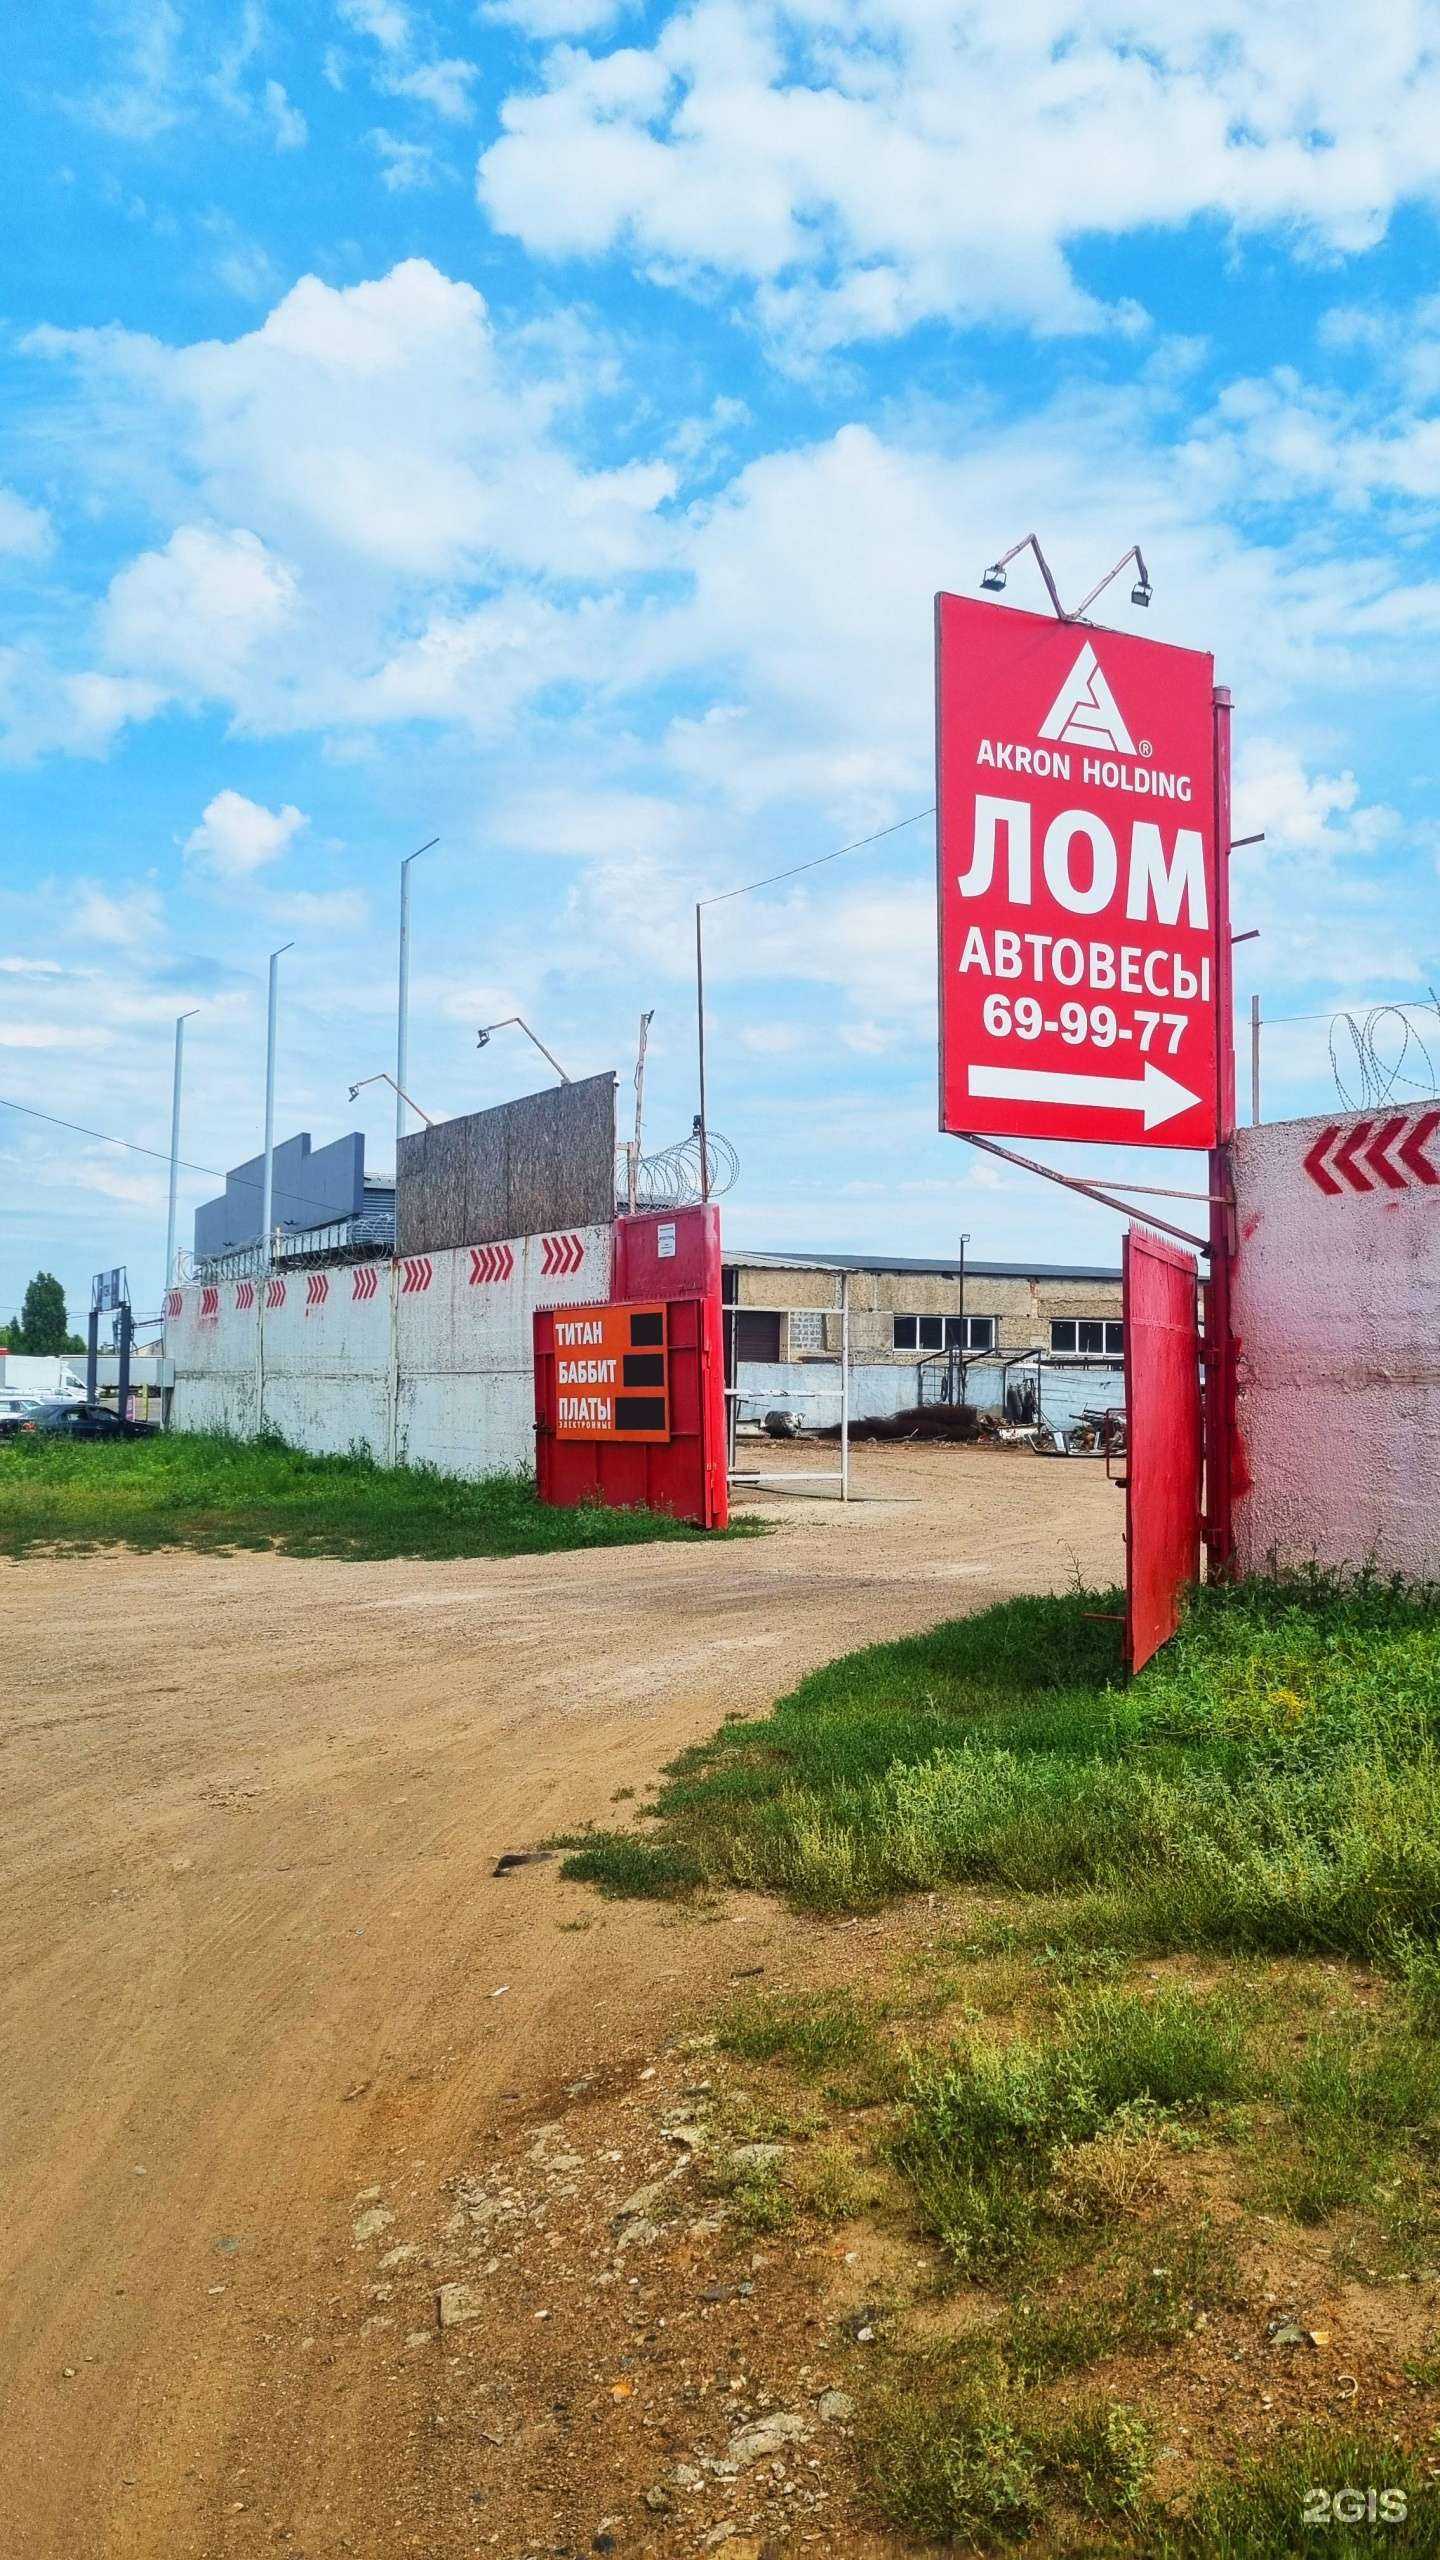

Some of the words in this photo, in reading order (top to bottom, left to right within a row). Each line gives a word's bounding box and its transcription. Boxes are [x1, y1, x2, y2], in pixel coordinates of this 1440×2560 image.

[976, 739, 1070, 781] AKRON
[1083, 758, 1192, 801] HOLDING
[957, 794, 1209, 930] ЛОМ
[958, 926, 1210, 1001] АВТОВЕСЫ
[983, 994, 1188, 1053] 69-99-77
[555, 1321, 603, 1345] ТИТАН
[558, 1360, 616, 1384] БАББИТ
[558, 1421, 611, 1429] ЭЛЕКТРОННЫЕ
[559, 1398, 611, 1420] ПЛАТЫ
